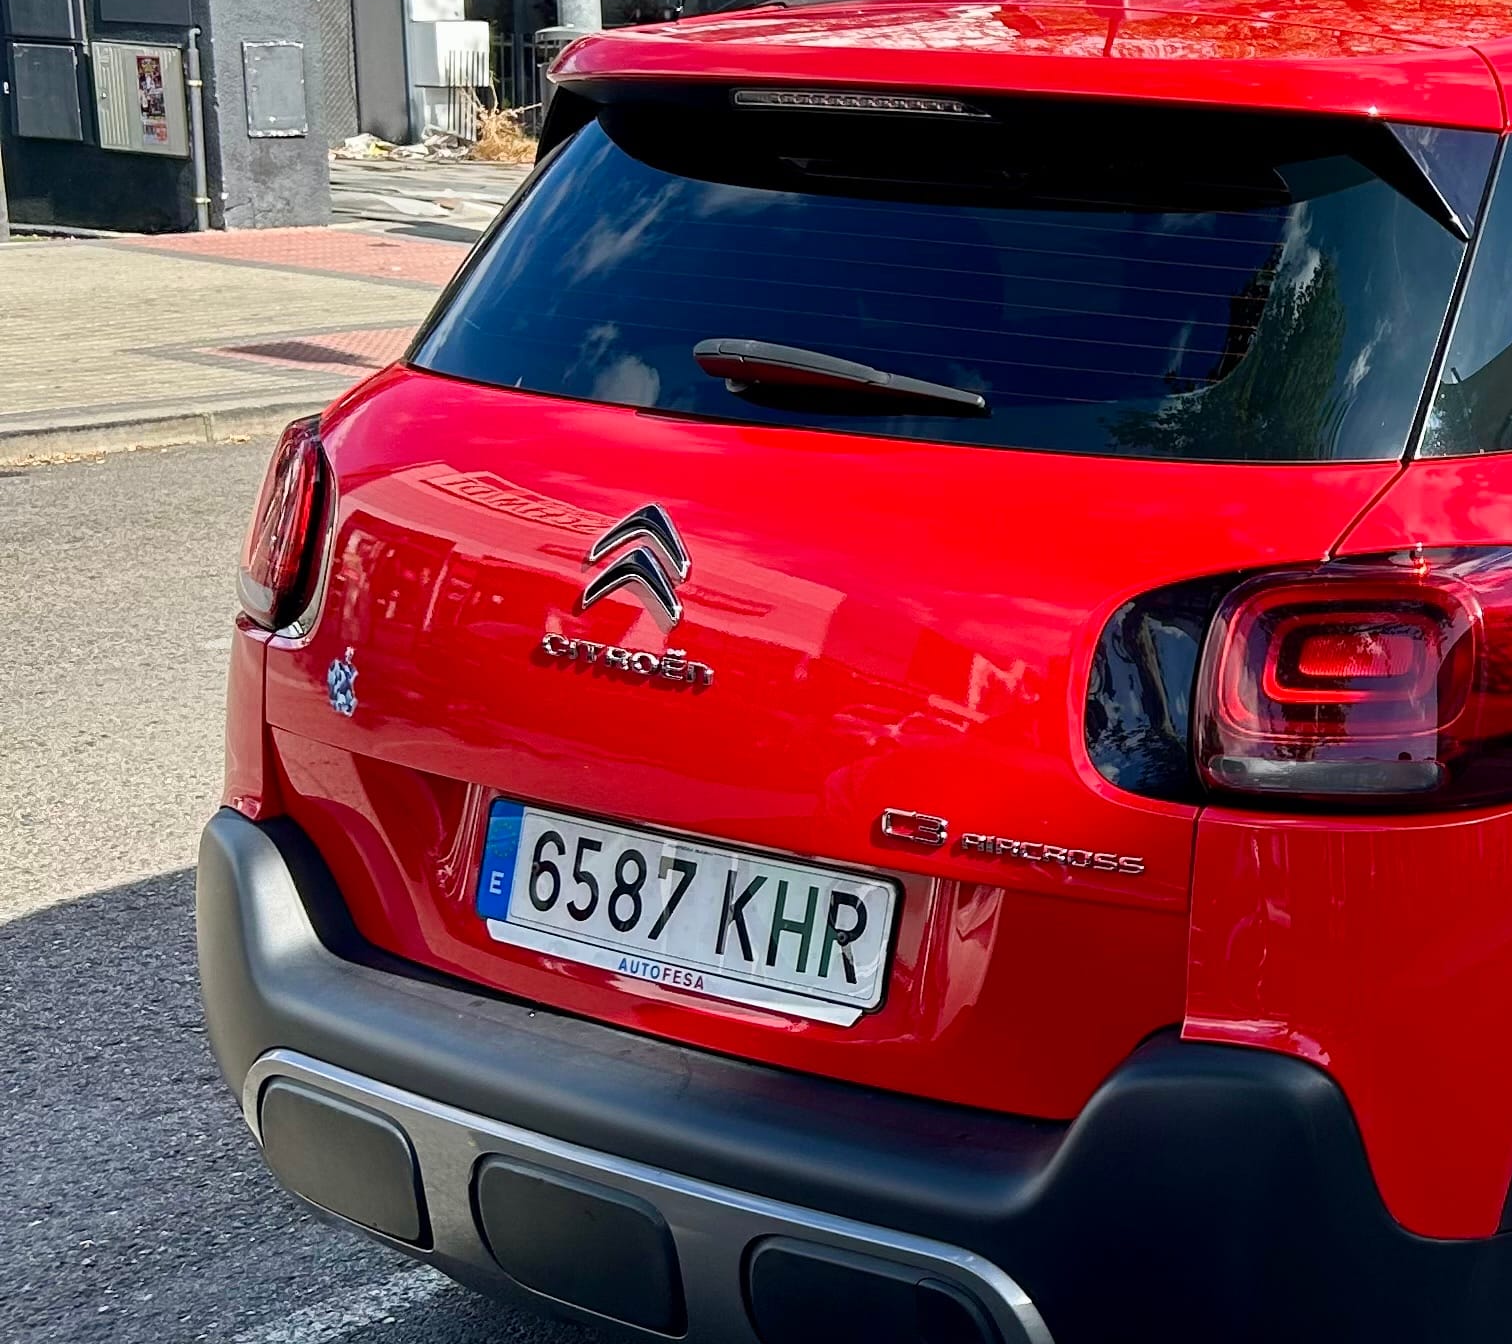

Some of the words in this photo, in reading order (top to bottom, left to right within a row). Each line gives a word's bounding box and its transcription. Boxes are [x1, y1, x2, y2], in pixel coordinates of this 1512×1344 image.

[542, 632, 714, 685] CITROËN
[882, 807, 948, 845] C3
[962, 833, 1144, 874] AIRCROSS
[488, 870, 505, 896] E
[528, 830, 697, 941] 6587
[715, 869, 868, 985] KHR
[618, 957, 704, 991] AUTOFESA
